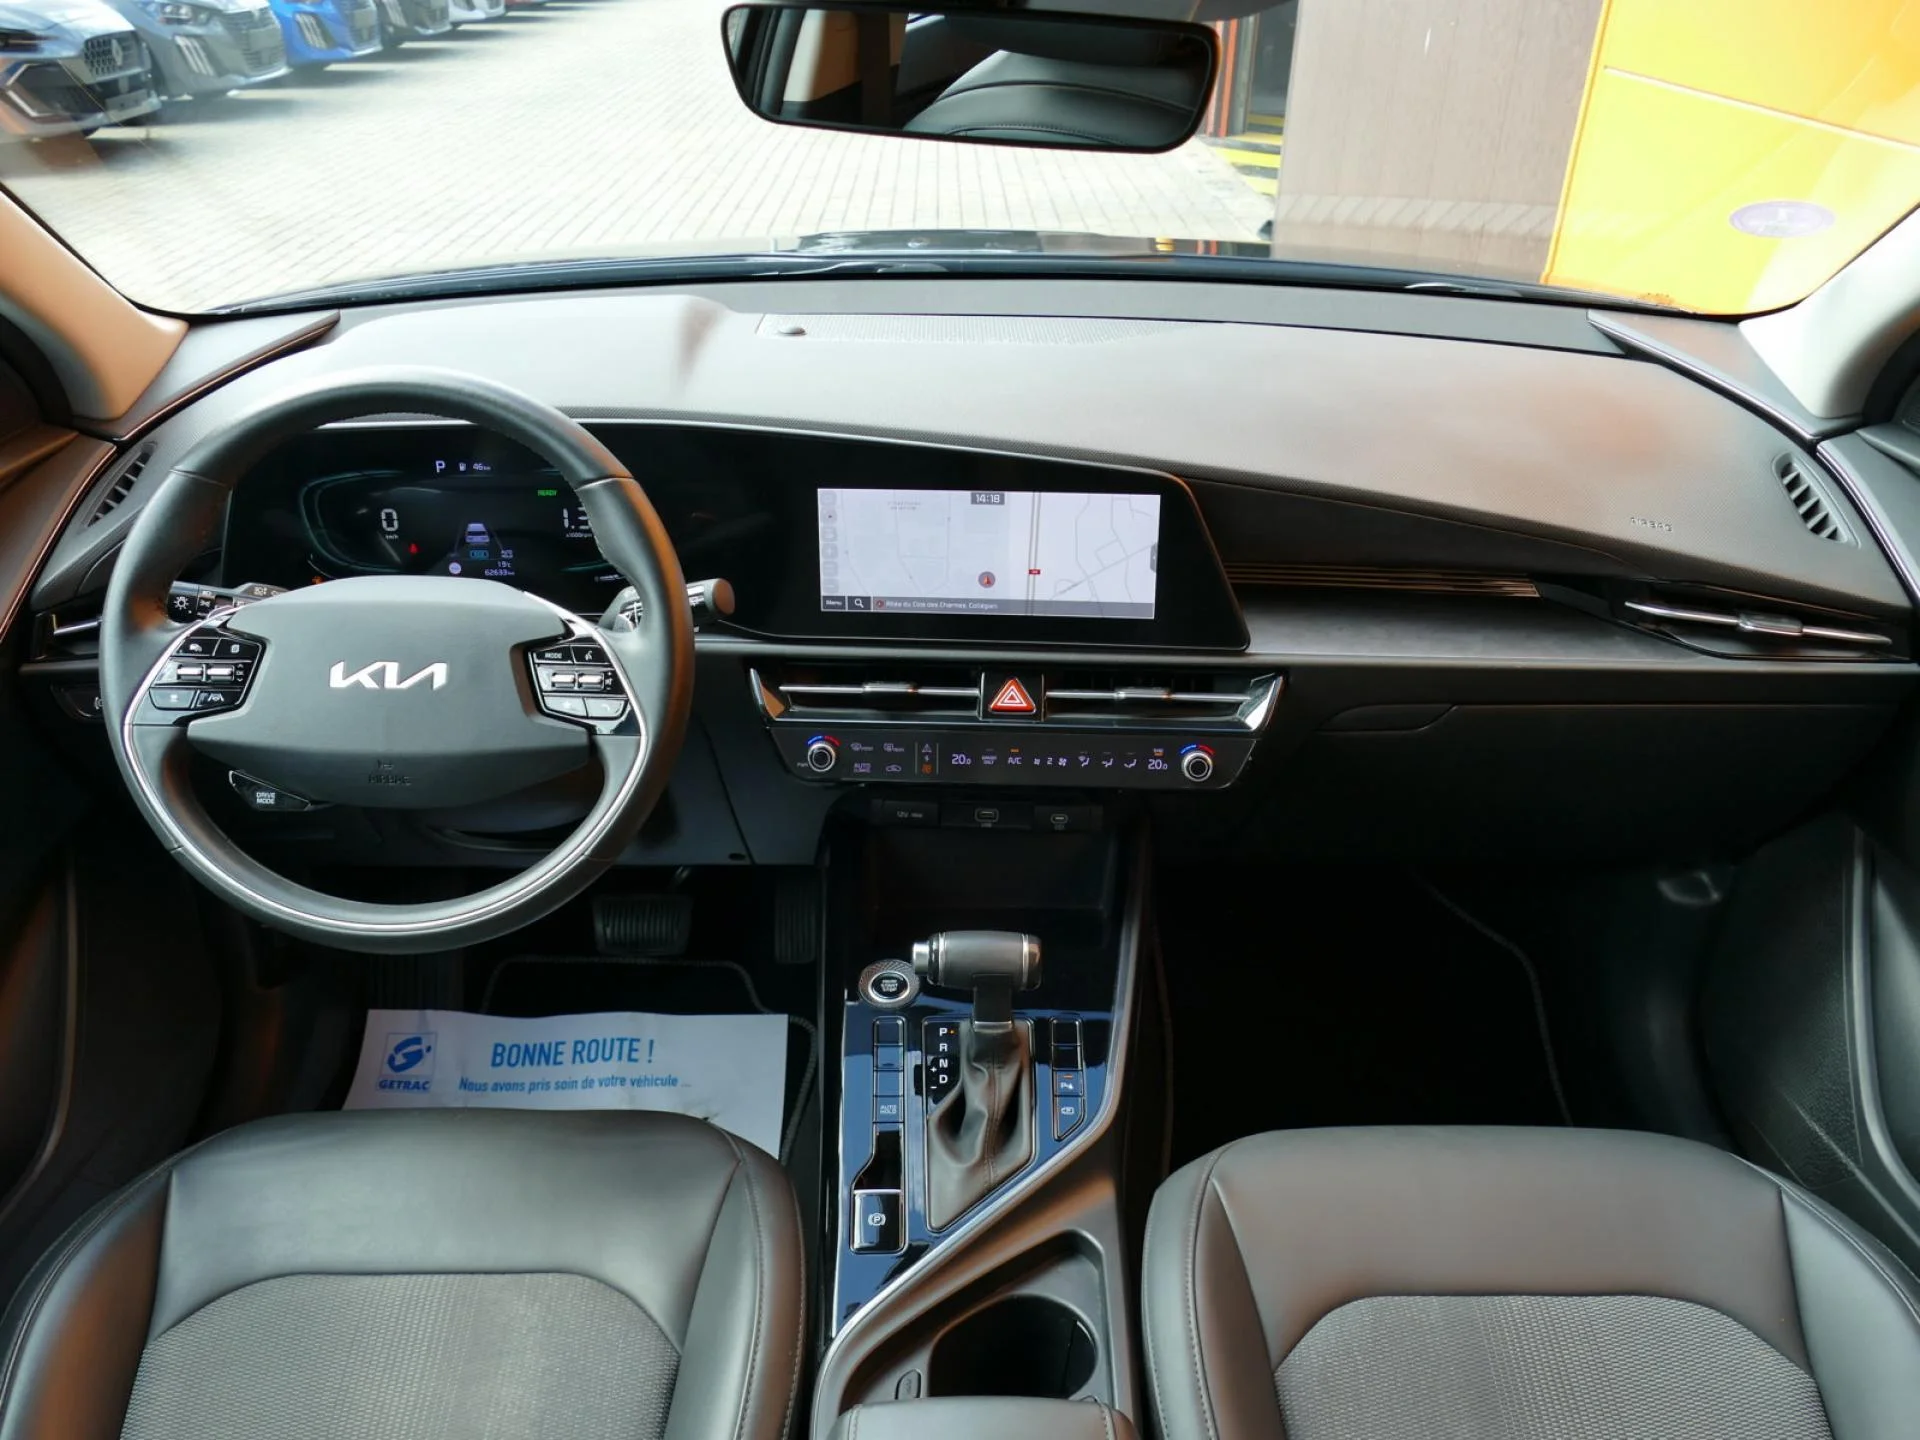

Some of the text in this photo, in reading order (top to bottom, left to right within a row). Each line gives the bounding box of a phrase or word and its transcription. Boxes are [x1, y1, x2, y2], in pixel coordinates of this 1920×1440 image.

[435, 460, 446, 473] P
[976, 494, 1000, 503] 14:18
[381, 508, 399, 532] 0
[329, 660, 448, 691] KIA
[1008, 757, 1022, 765] A/C
[939, 1028, 948, 1037] P
[491, 1041, 566, 1067] BONNE
[572, 1037, 641, 1064] ROUTE
[939, 1043, 948, 1052] R
[939, 1059, 948, 1068] N
[458, 1077, 488, 1092] Nous
[491, 1081, 525, 1093] avons
[527, 1077, 550, 1094] pris
[555, 1076, 578, 1090] soin
[581, 1076, 595, 1088] de
[599, 1074, 626, 1088] votre
[939, 1074, 948, 1084] D
[378, 1080, 430, 1091] GETRAC
